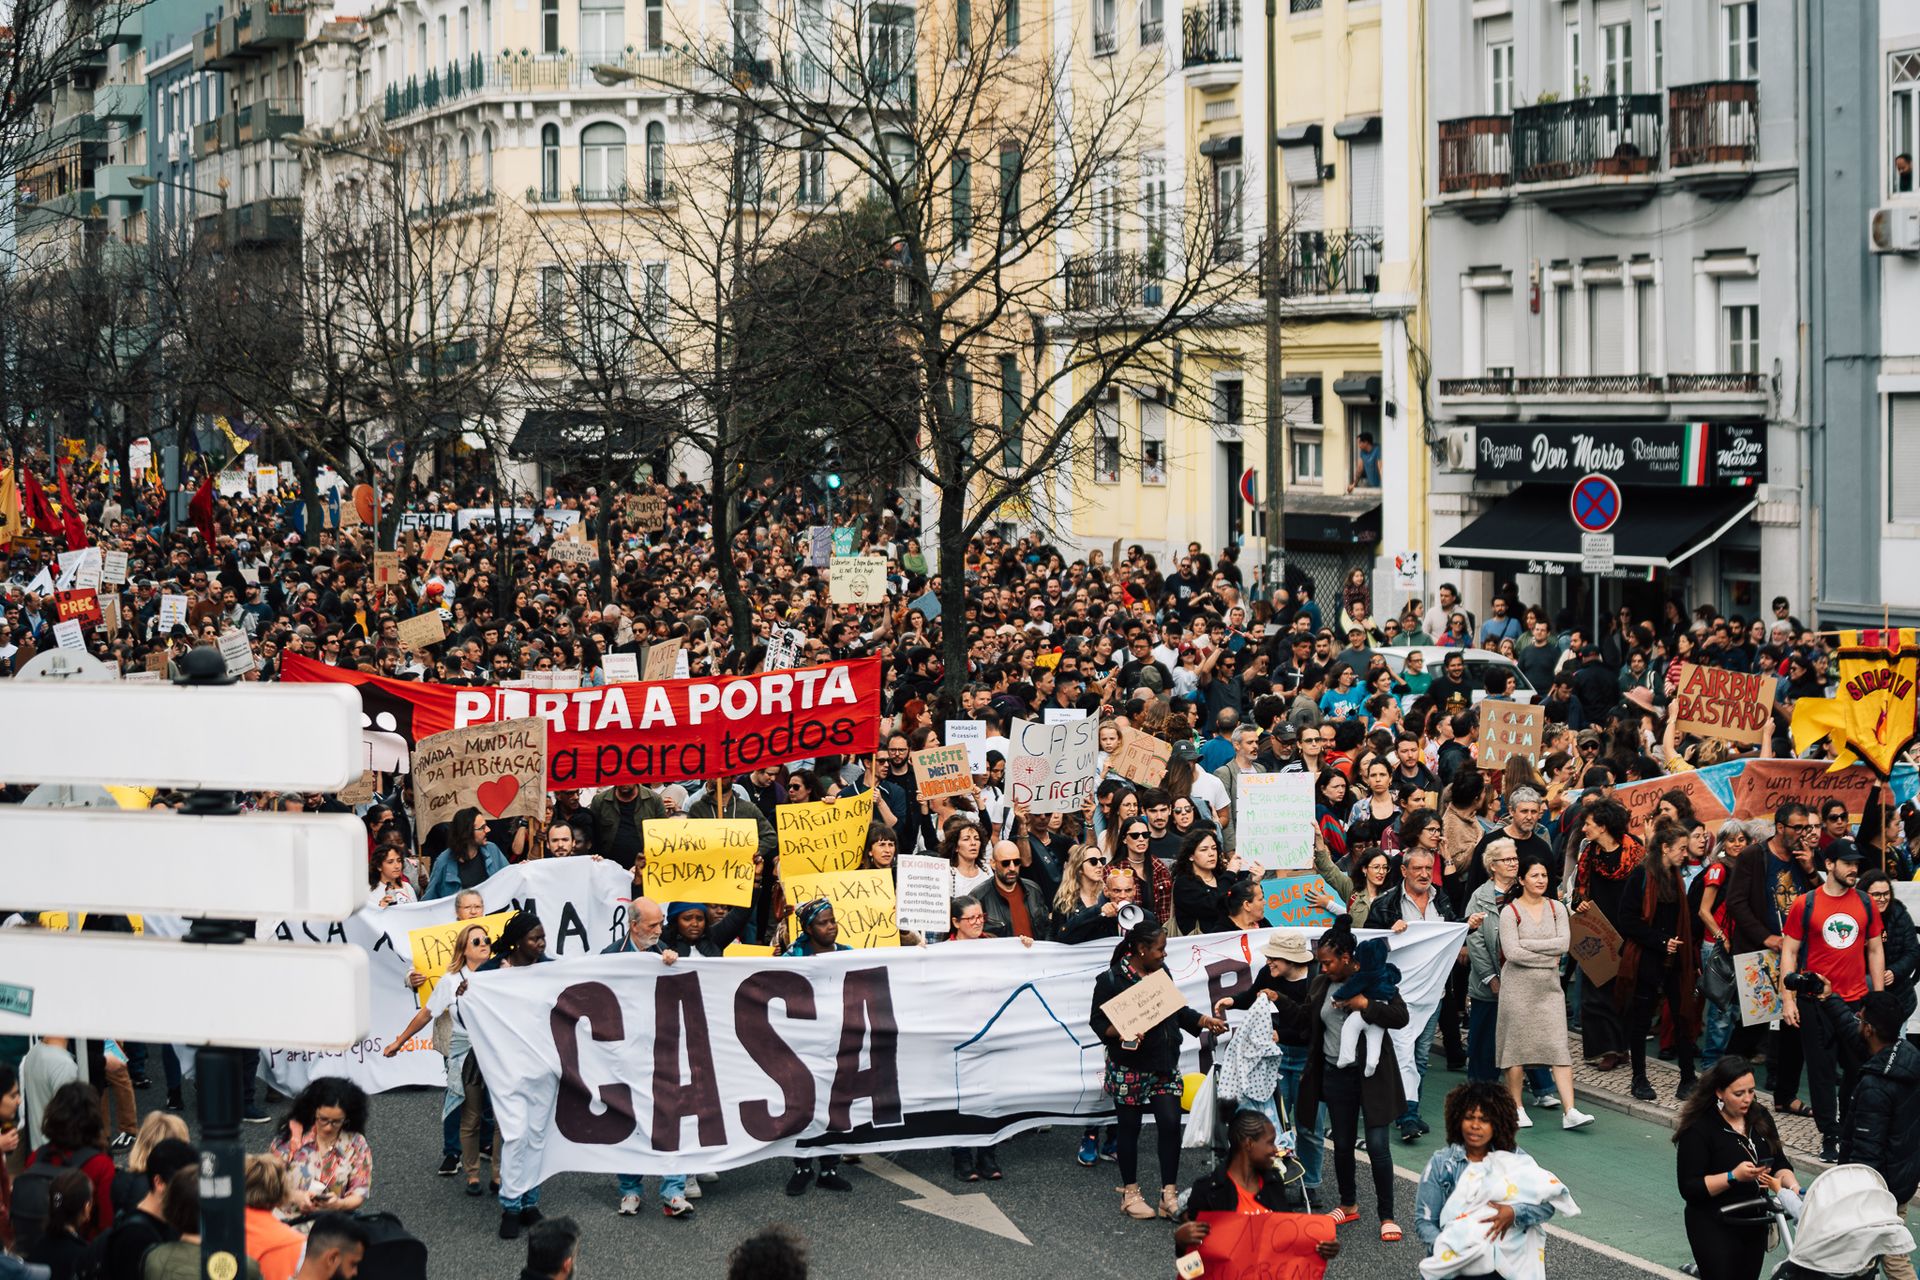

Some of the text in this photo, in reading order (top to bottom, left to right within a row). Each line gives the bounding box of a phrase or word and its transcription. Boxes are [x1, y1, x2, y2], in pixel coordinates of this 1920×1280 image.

[1480, 433, 1680, 473] Pizzeria Don Mario Ristorante
[1733, 437, 1763, 455] Don
[1650, 462, 1680, 471] ITALIANO
[1717, 449, 1758, 467] Mario
[1528, 559, 1543, 574] Don
[1544, 561, 1565, 575] Mario
[650, 643, 675, 666] MORTE
[640, 686, 678, 730] A
[688, 665, 857, 725] PORTA
[1488, 710, 1534, 727] A CASA
[1486, 727, 1532, 746] A QUEM
[597, 738, 706, 783] para
[722, 713, 857, 773] todos
[1485, 746, 1496, 760] A
[1054, 752, 1095, 775] É UM
[427, 770, 445, 783] DA
[1630, 787, 1664, 808] Corpo
[1766, 775, 1792, 790] um
[1799, 766, 1870, 791] Planeta
[1012, 775, 1095, 804] DIREITO
[647, 861, 716, 887] RENDAS
[901, 860, 946, 871] EXIGIMOS
[792, 877, 891, 904] BAIXAR
[907, 883, 940, 891] renovação
[1268, 878, 1325, 910] QUERO
[900, 907, 947, 915] arrendamento
[549, 965, 904, 1154] CASA
